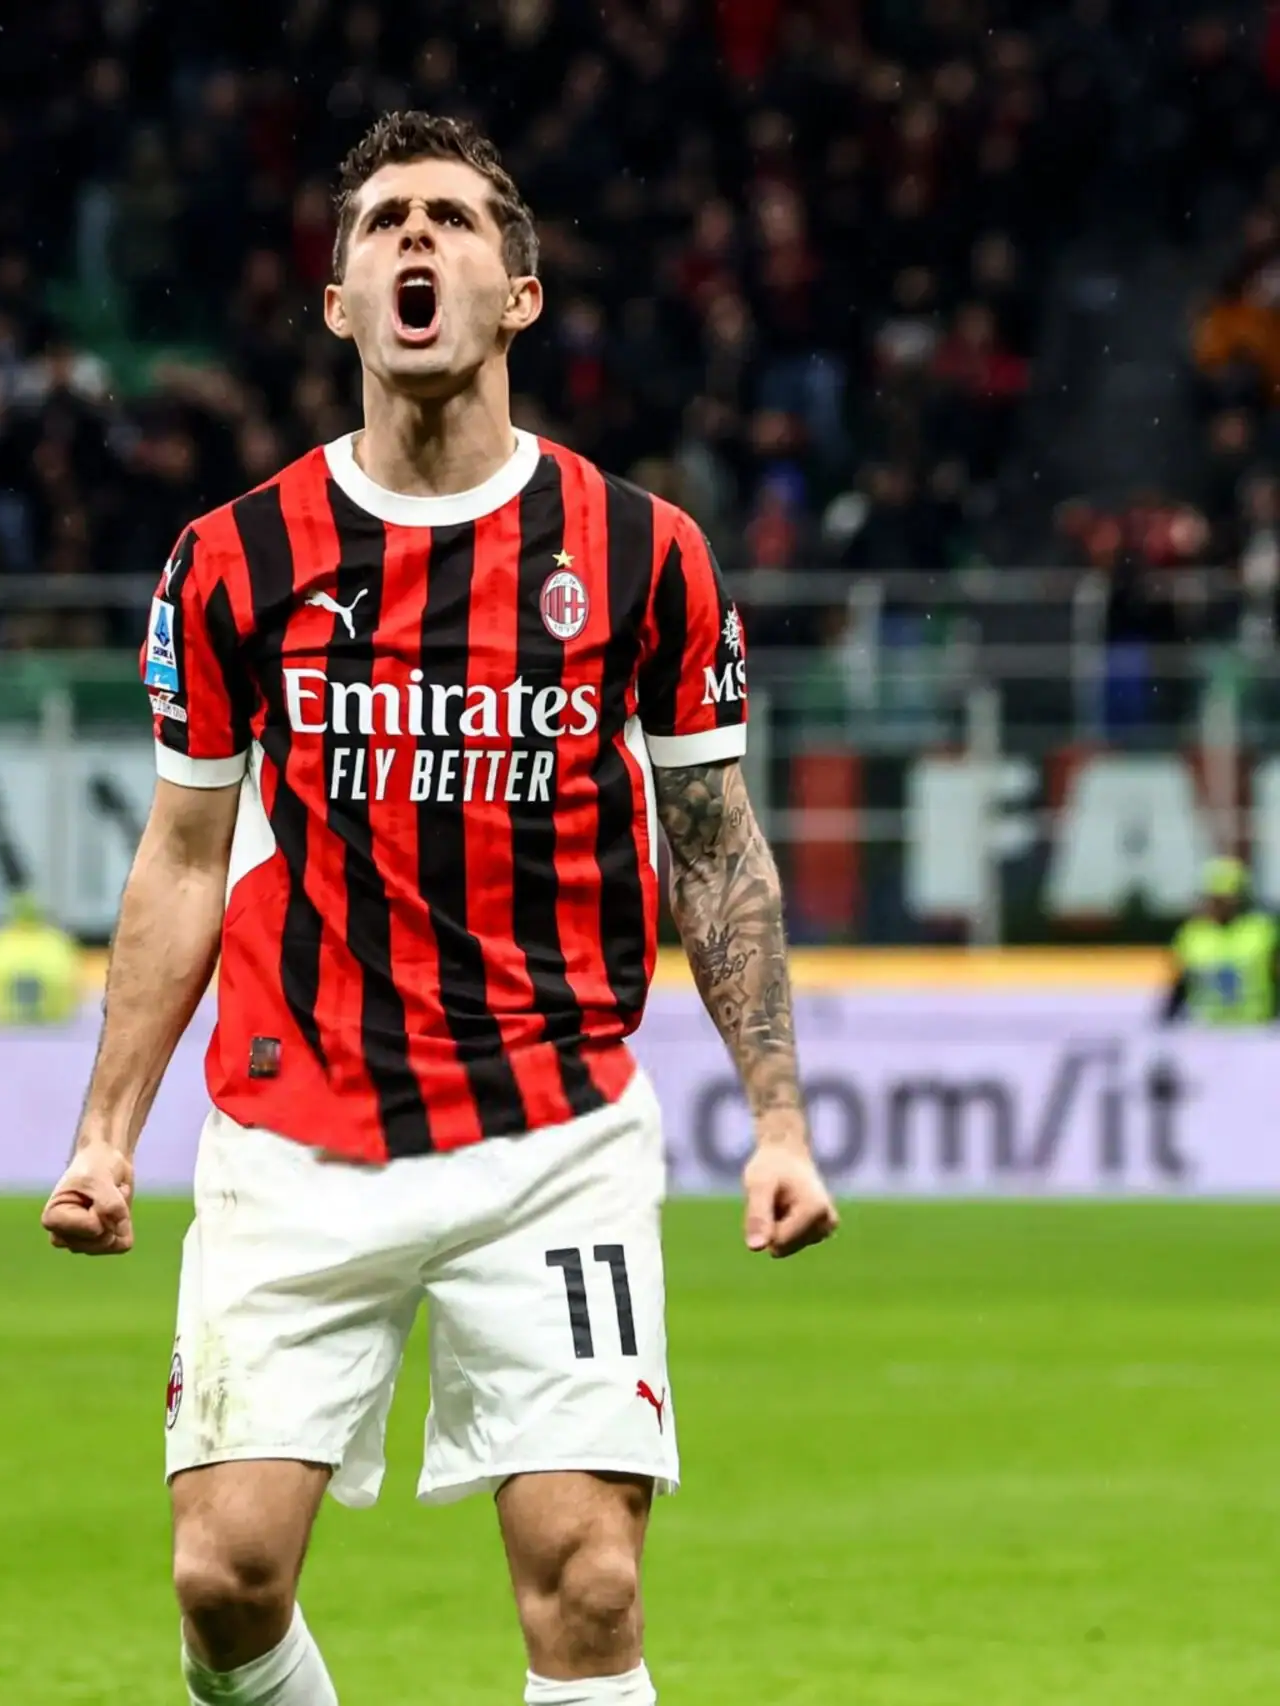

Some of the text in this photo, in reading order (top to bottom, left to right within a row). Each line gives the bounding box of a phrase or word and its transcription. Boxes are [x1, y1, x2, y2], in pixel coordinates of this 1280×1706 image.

[282, 668, 598, 738] Emirates
[329, 747, 555, 802] FLY BETTER
[545, 1244, 638, 1359] 11
